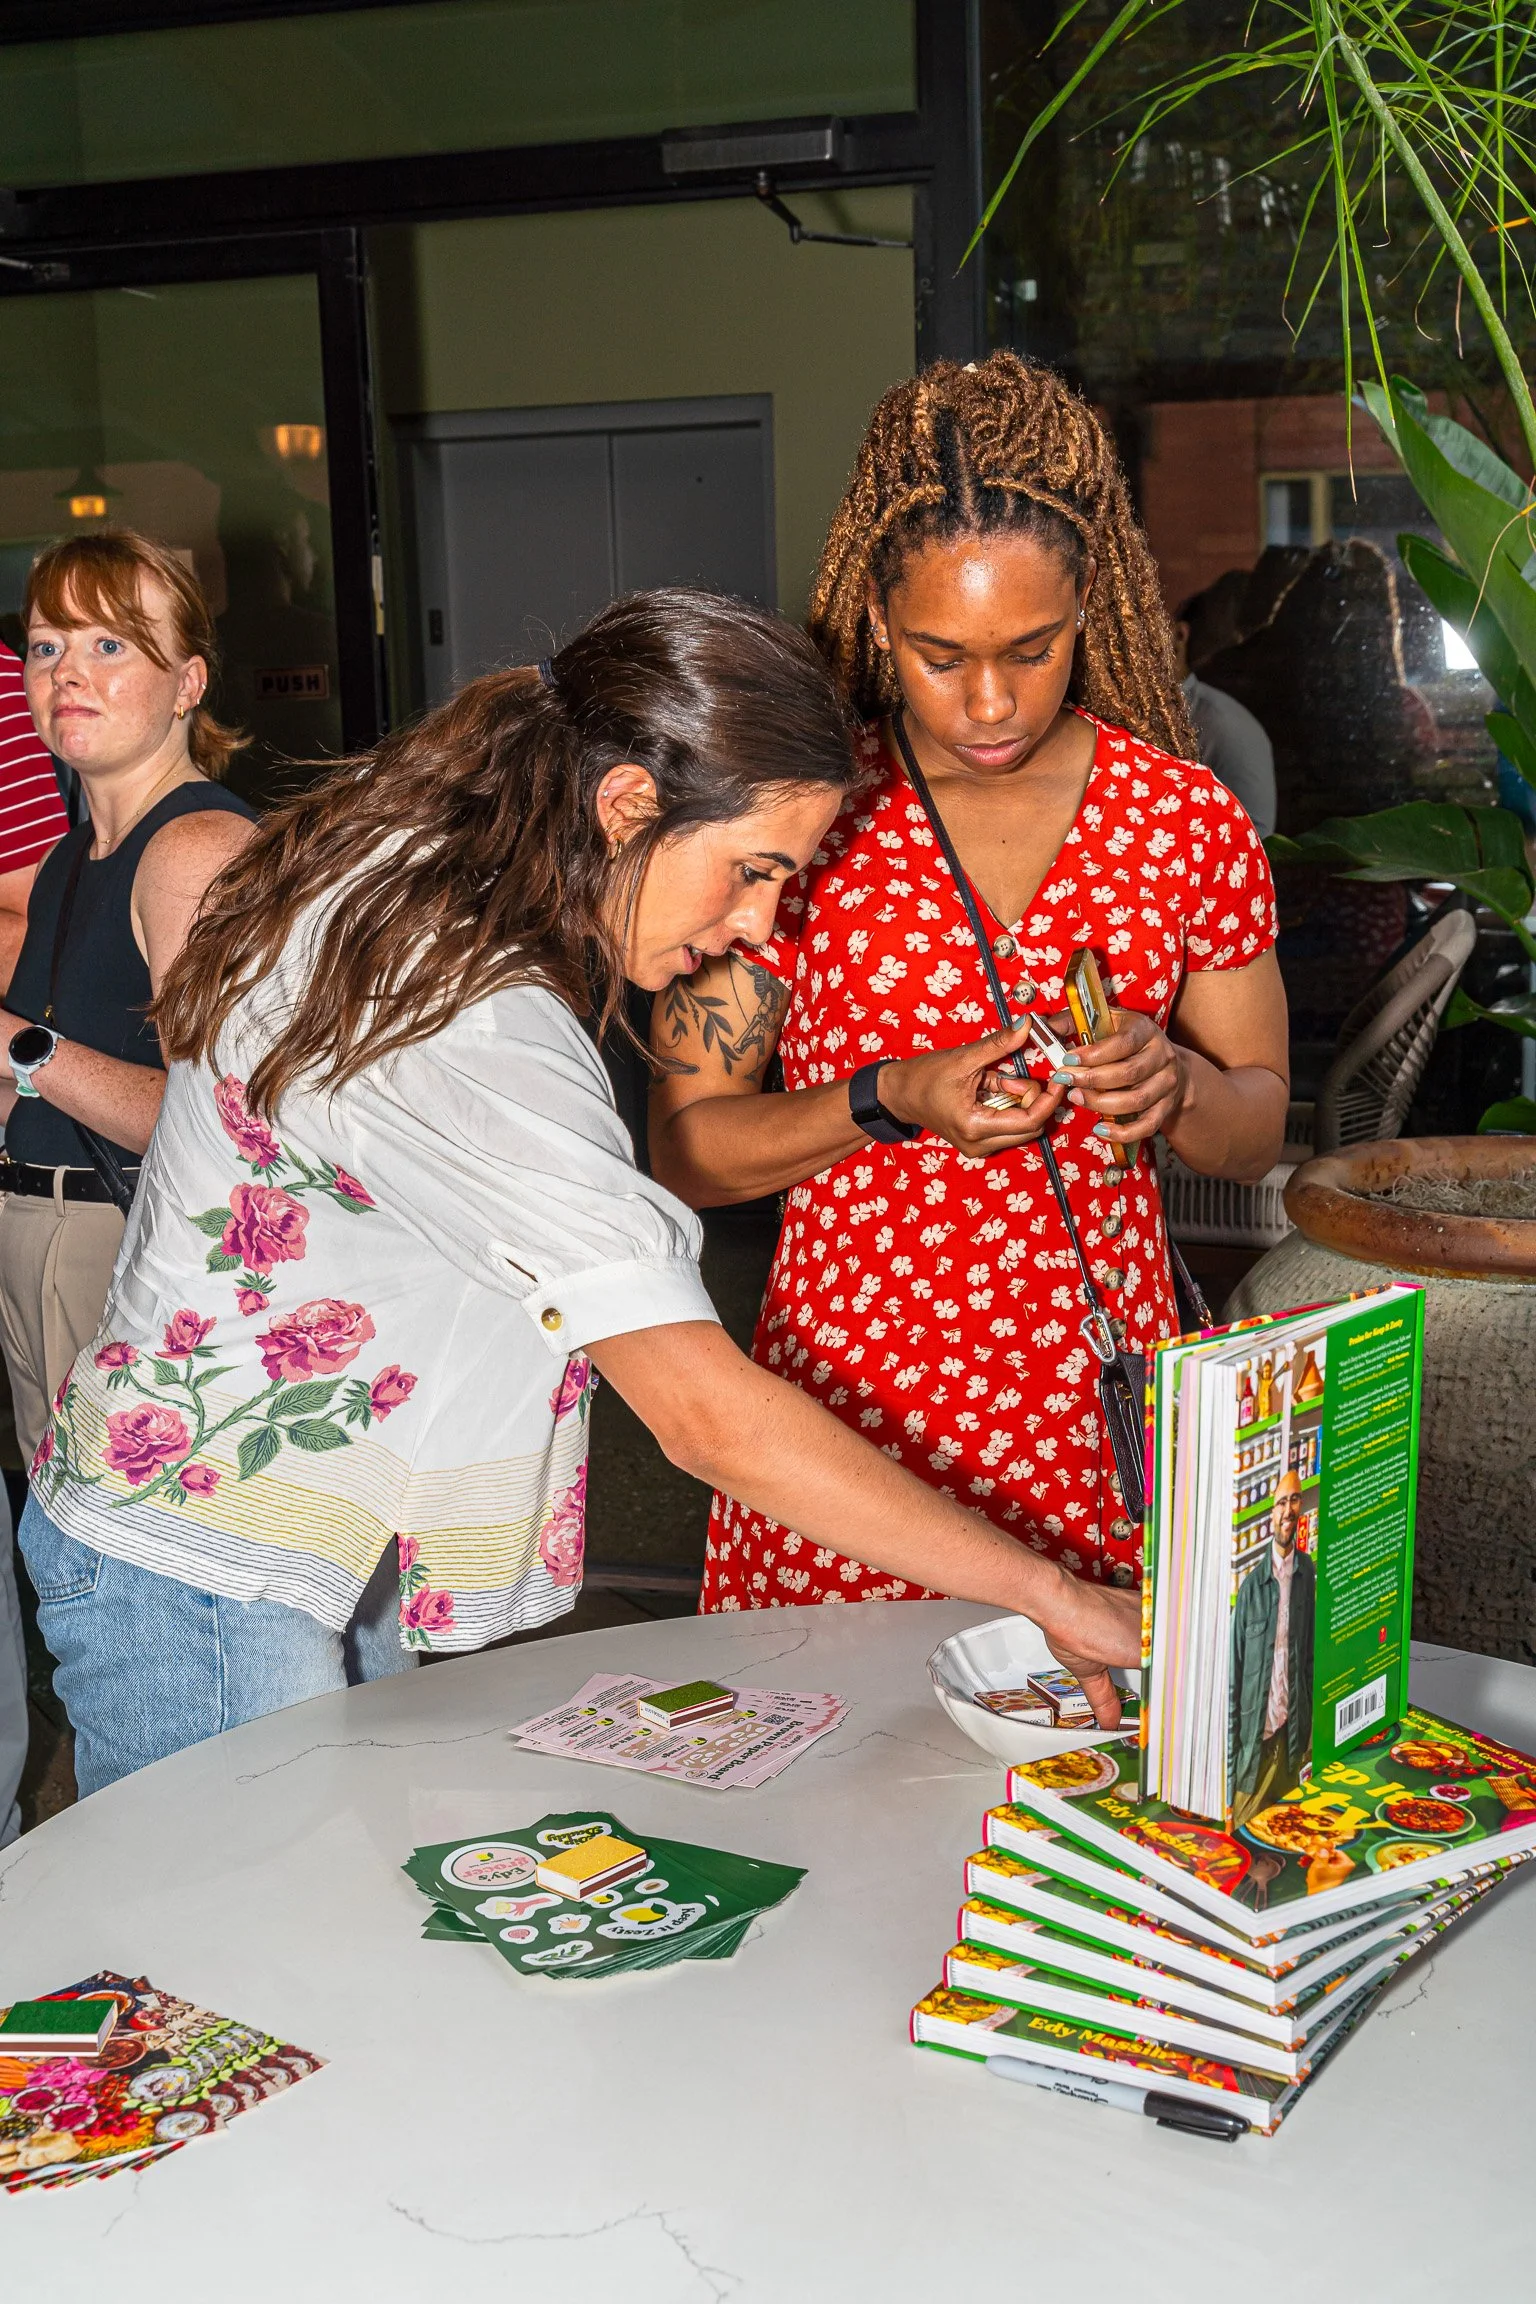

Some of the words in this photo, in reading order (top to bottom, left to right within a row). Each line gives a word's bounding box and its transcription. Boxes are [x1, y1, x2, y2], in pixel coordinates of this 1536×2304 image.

[261, 673, 319, 692] PUSH
[766, 1720, 805, 1744] Brown
[740, 1740, 774, 1760] Paper
[1455, 1732, 1503, 1755] Lebanese
[1478, 1752, 1516, 1771] Grocer
[1320, 1761, 1370, 1786] ep
[1095, 1797, 1135, 1819] Edy
[1129, 1816, 1200, 1856] Massih
[463, 1856, 529, 1878] grocer
[478, 1866, 527, 1882] Edy's
[671, 1907, 695, 1926] Keep
[607, 1925, 656, 1936] Zesty
[657, 1924, 674, 1932] It
[1028, 2016, 1077, 2039] Edy
[1078, 2028, 1168, 2060] Massih
